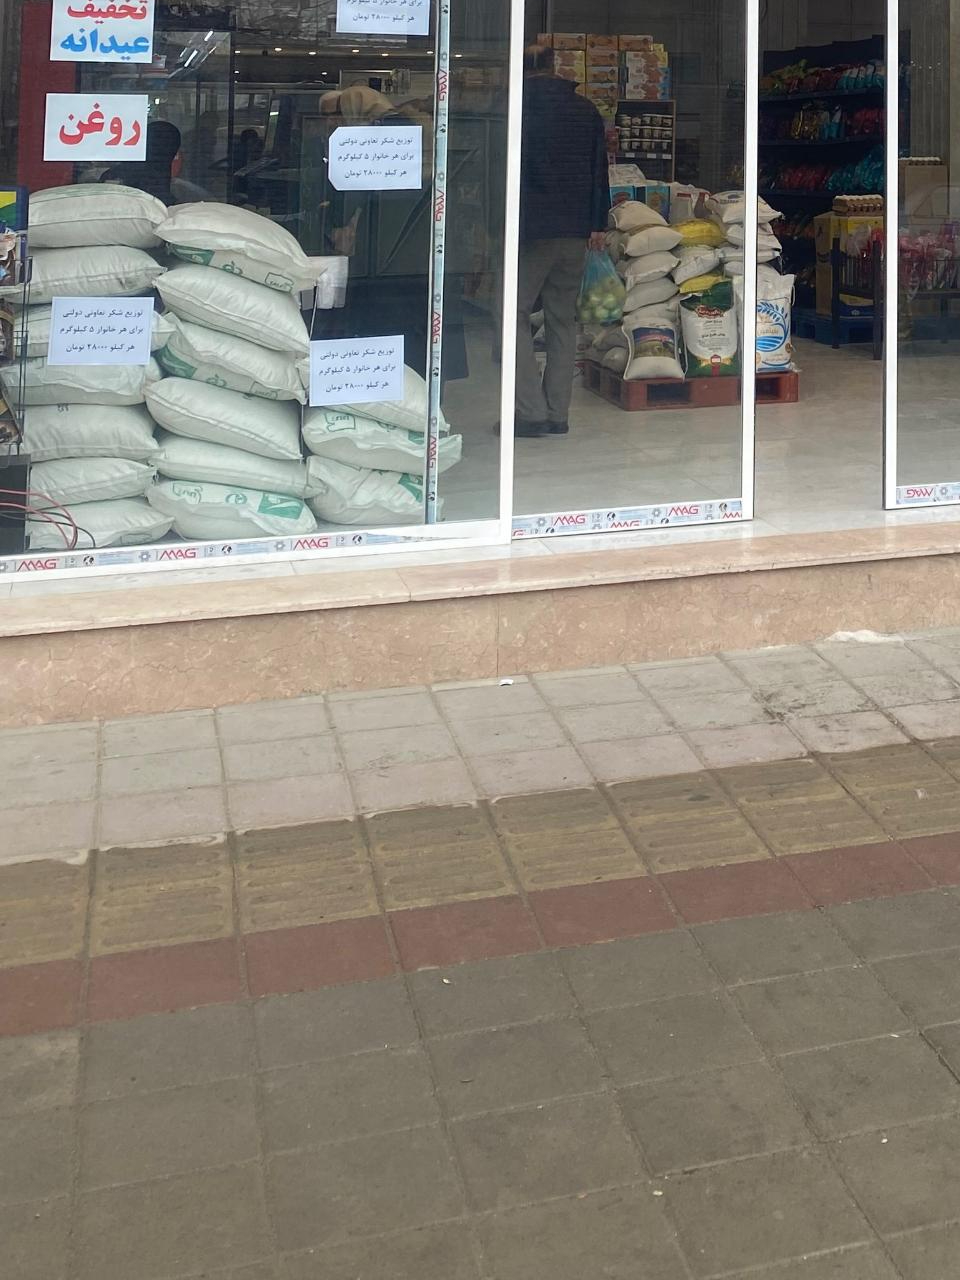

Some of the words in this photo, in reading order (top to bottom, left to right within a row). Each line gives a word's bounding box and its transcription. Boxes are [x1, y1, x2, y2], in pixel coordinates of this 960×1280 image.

[60, 27, 149, 61] عیدانه
[59, 102, 141, 146] روغن
[668, 505, 699, 516] MAG
[553, 514, 586, 526] MAG
[293, 537, 329, 550] MAG
[160, 548, 196, 560] MAG
[17, 558, 57, 571] MAG
